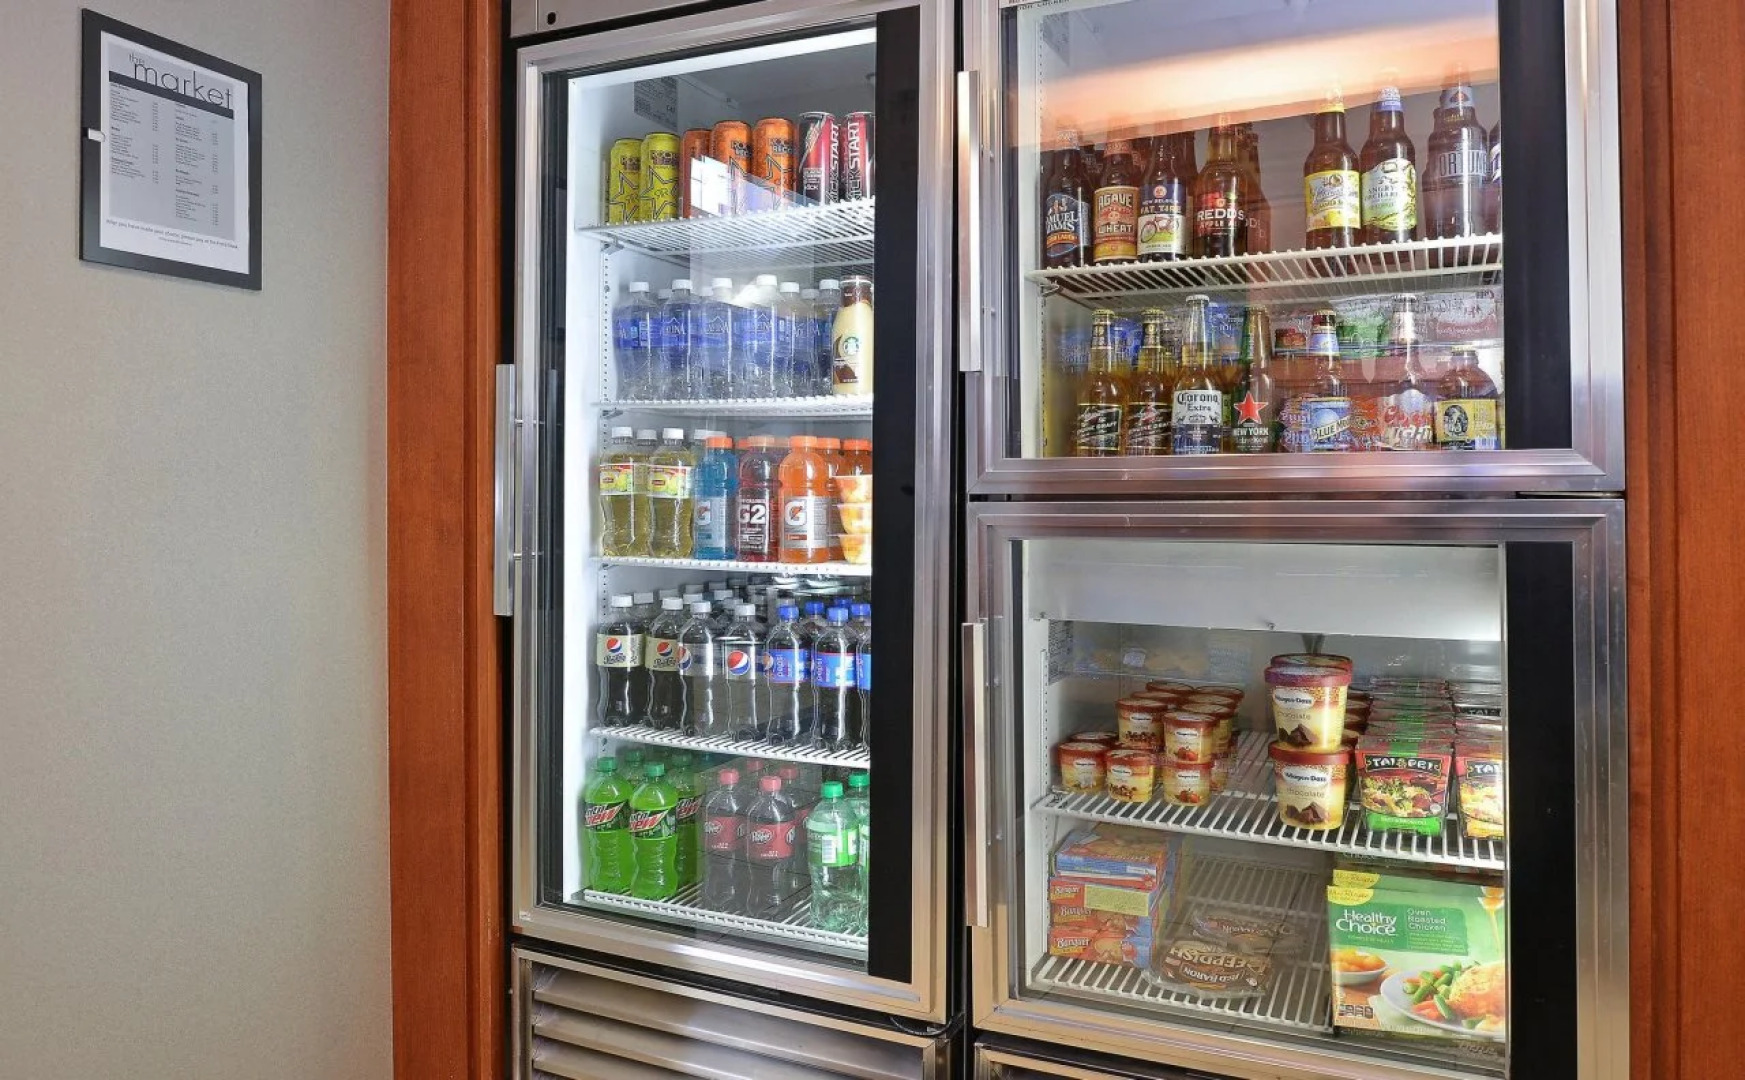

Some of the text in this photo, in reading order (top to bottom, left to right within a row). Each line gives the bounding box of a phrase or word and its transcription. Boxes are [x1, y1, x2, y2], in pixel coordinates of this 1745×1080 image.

[134, 63, 232, 111] market
[1439, 149, 1487, 177] ORTUNE
[1098, 193, 1133, 210] AGAVE
[1046, 210, 1079, 223] AMUEL
[1046, 219, 1075, 233] DAMS
[1177, 391, 1220, 406] Corona
[1187, 403, 1212, 412] Extra
[1248, 427, 1269, 436] YORK
[784, 501, 808, 526] G
[1373, 757, 1433, 770] TAI PEI
[1342, 908, 1432, 925] Healthy Oven
[1335, 915, 1446, 935] Choice Roasted
[1407, 923, 1446, 931] Chicken
